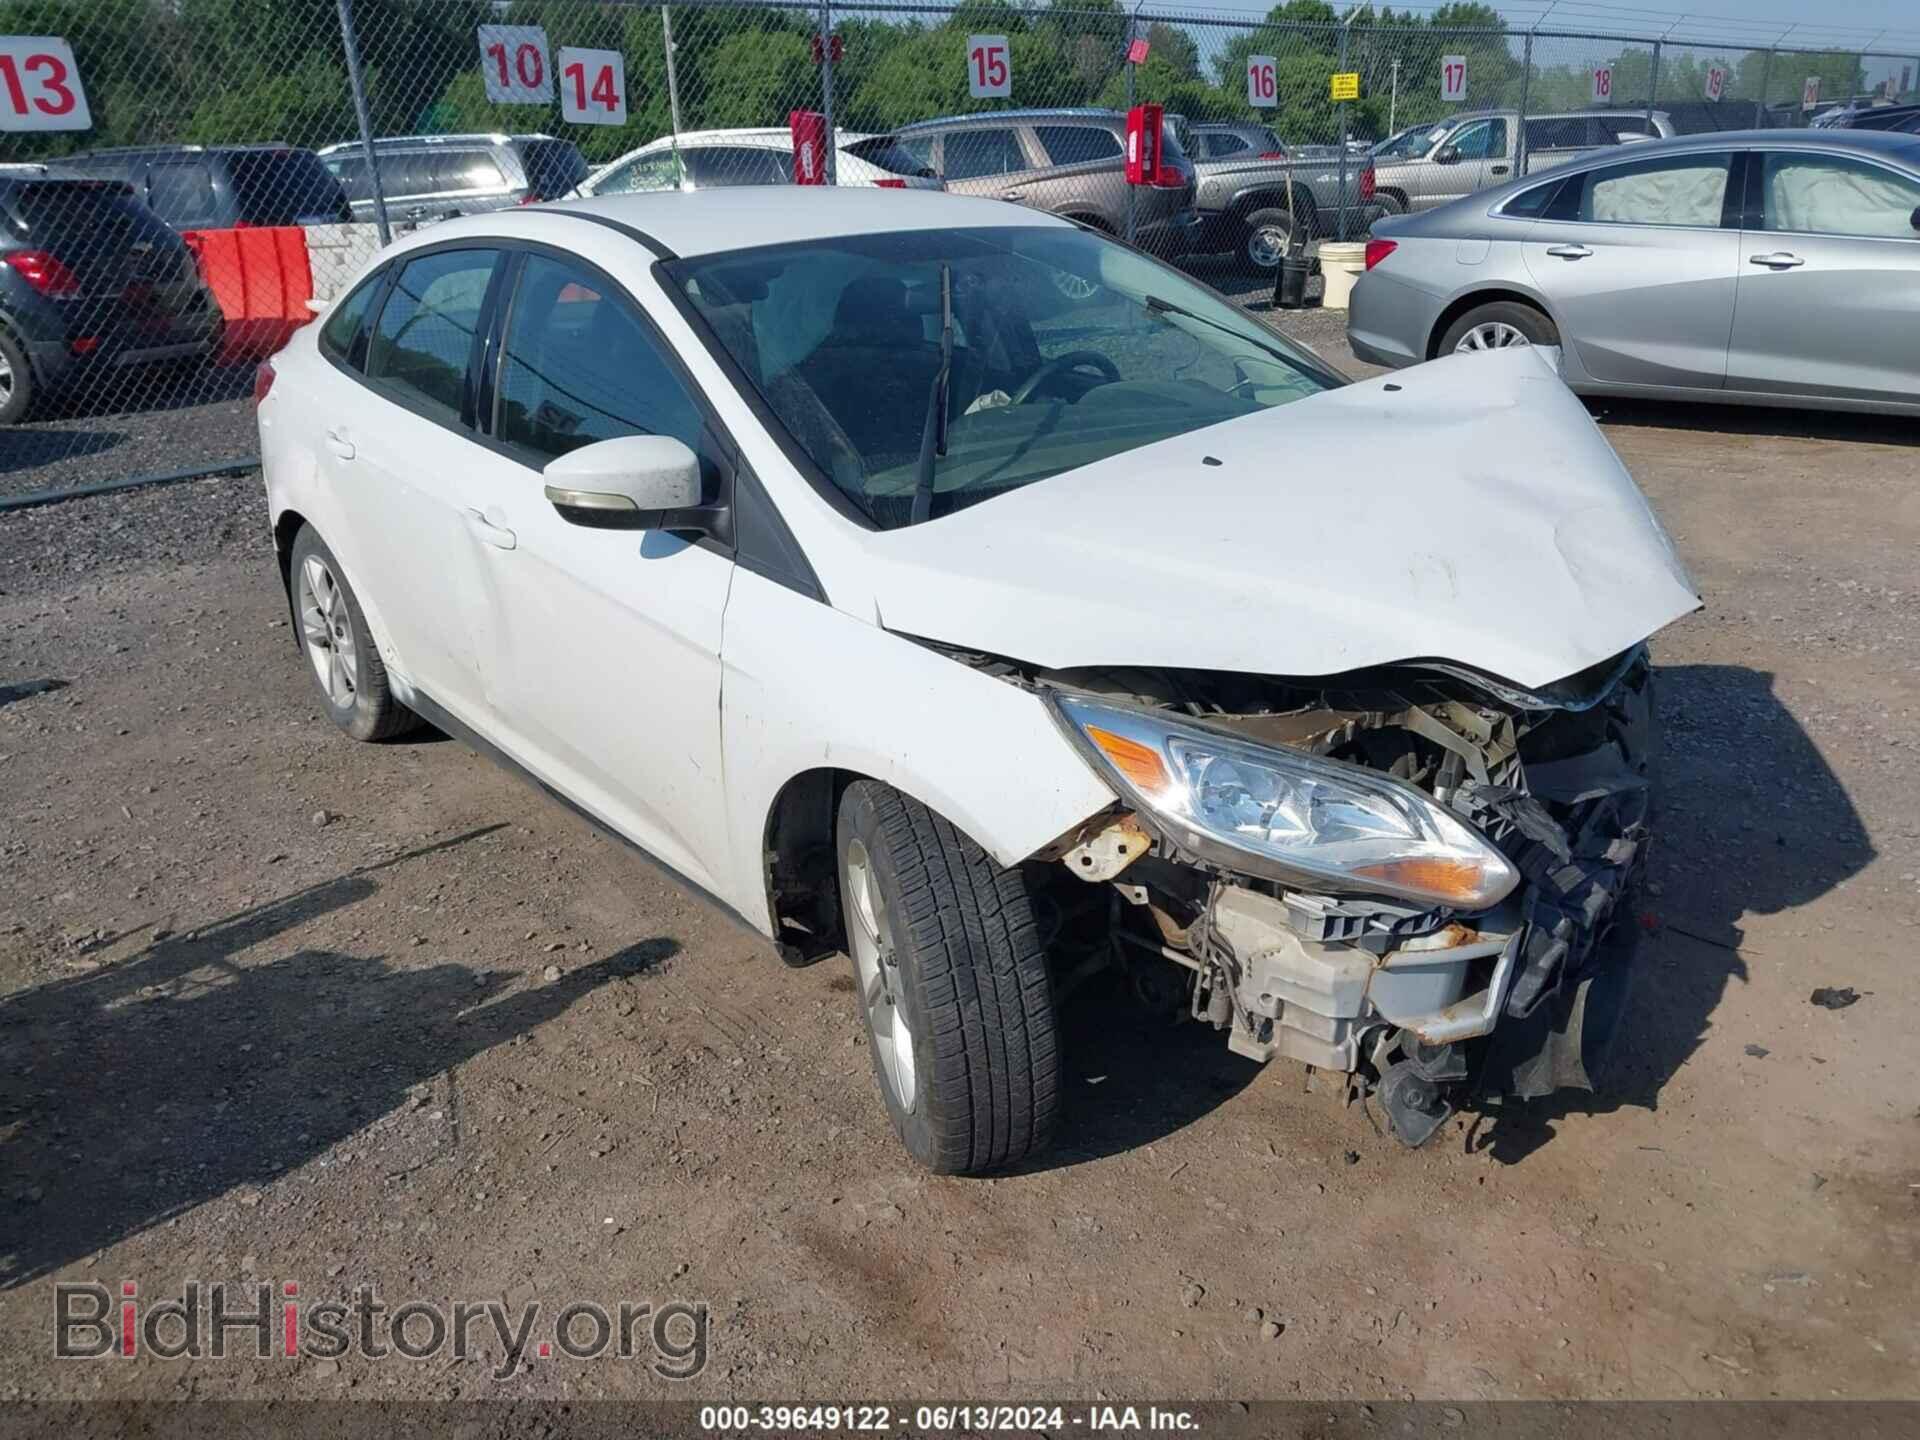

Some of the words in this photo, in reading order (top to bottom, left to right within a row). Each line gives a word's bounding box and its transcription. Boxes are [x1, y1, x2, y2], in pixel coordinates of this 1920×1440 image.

[0, 54, 76, 115] 13
[487, 43, 543, 88] 10
[972, 47, 1007, 86] 15
[1250, 65, 1274, 97] 16
[1445, 64, 1464, 93] 17
[1595, 70, 1609, 96] 18
[565, 62, 620, 112] 14
